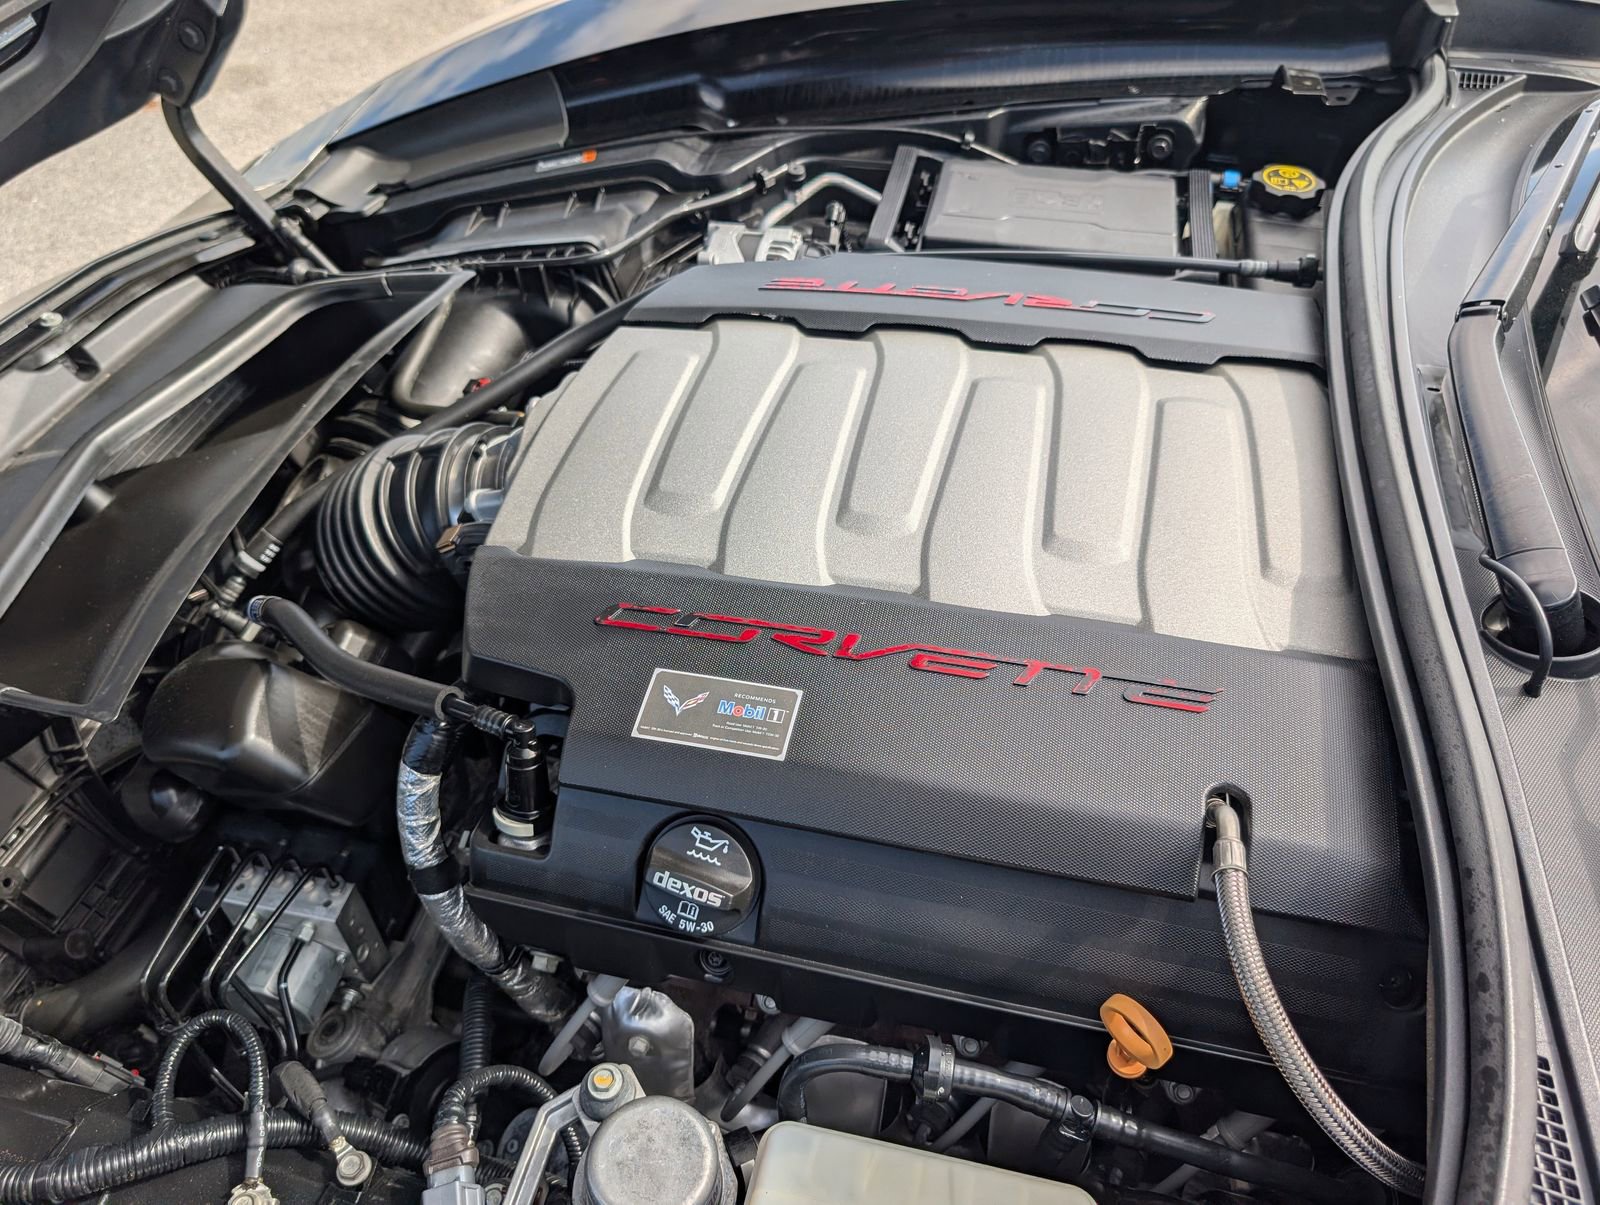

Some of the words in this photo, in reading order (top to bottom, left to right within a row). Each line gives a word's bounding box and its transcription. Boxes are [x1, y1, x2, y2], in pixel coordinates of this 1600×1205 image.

[758, 277, 1216, 324] CORVETTE
[595, 602, 1225, 714] CORVETTE
[717, 699, 767, 721] Mobil
[734, 692, 777, 704] RECOMMENDS
[652, 870, 724, 908] dexos
[658, 904, 677, 924] SAE
[678, 918, 715, 933] 5W-30
